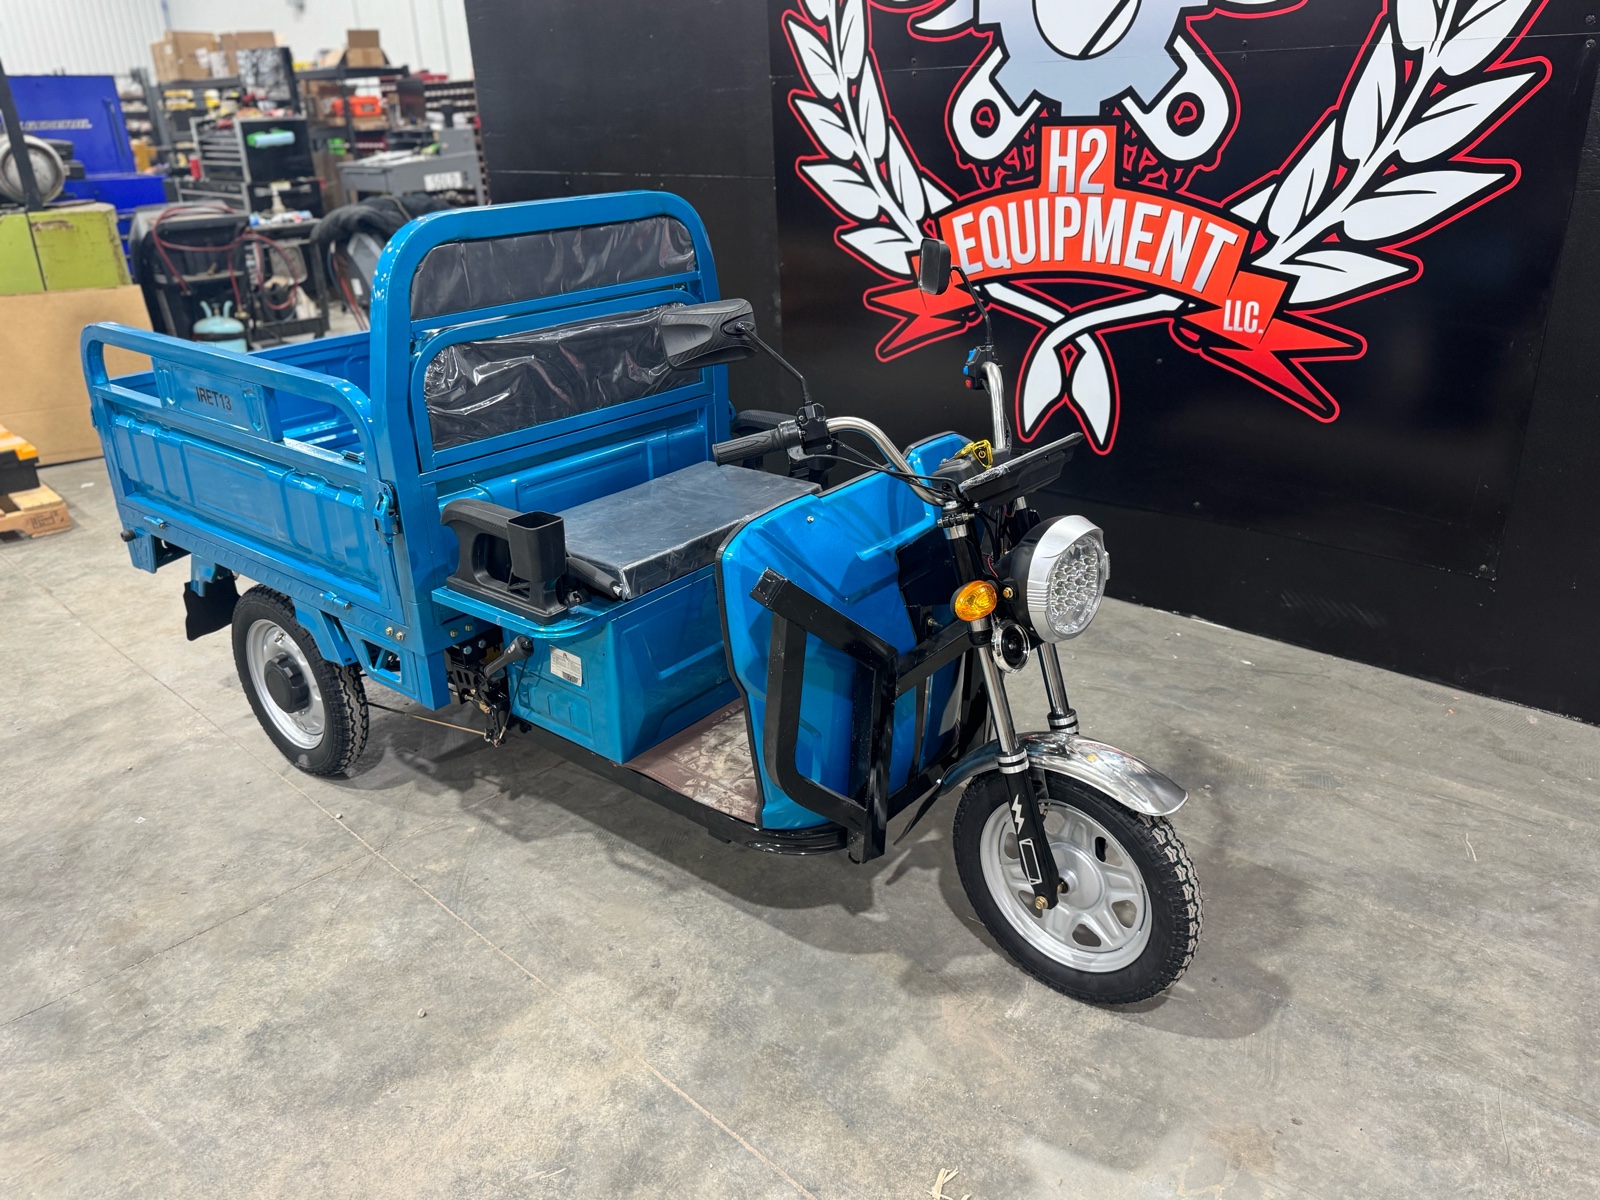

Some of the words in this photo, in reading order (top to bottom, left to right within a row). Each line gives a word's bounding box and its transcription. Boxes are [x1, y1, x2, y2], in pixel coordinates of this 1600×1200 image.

[1049, 128, 1107, 194] H2
[952, 197, 1239, 294] EQUIPMENT
[1223, 300, 1263, 335] LLC.
[195, 386, 232, 411] IRET13
